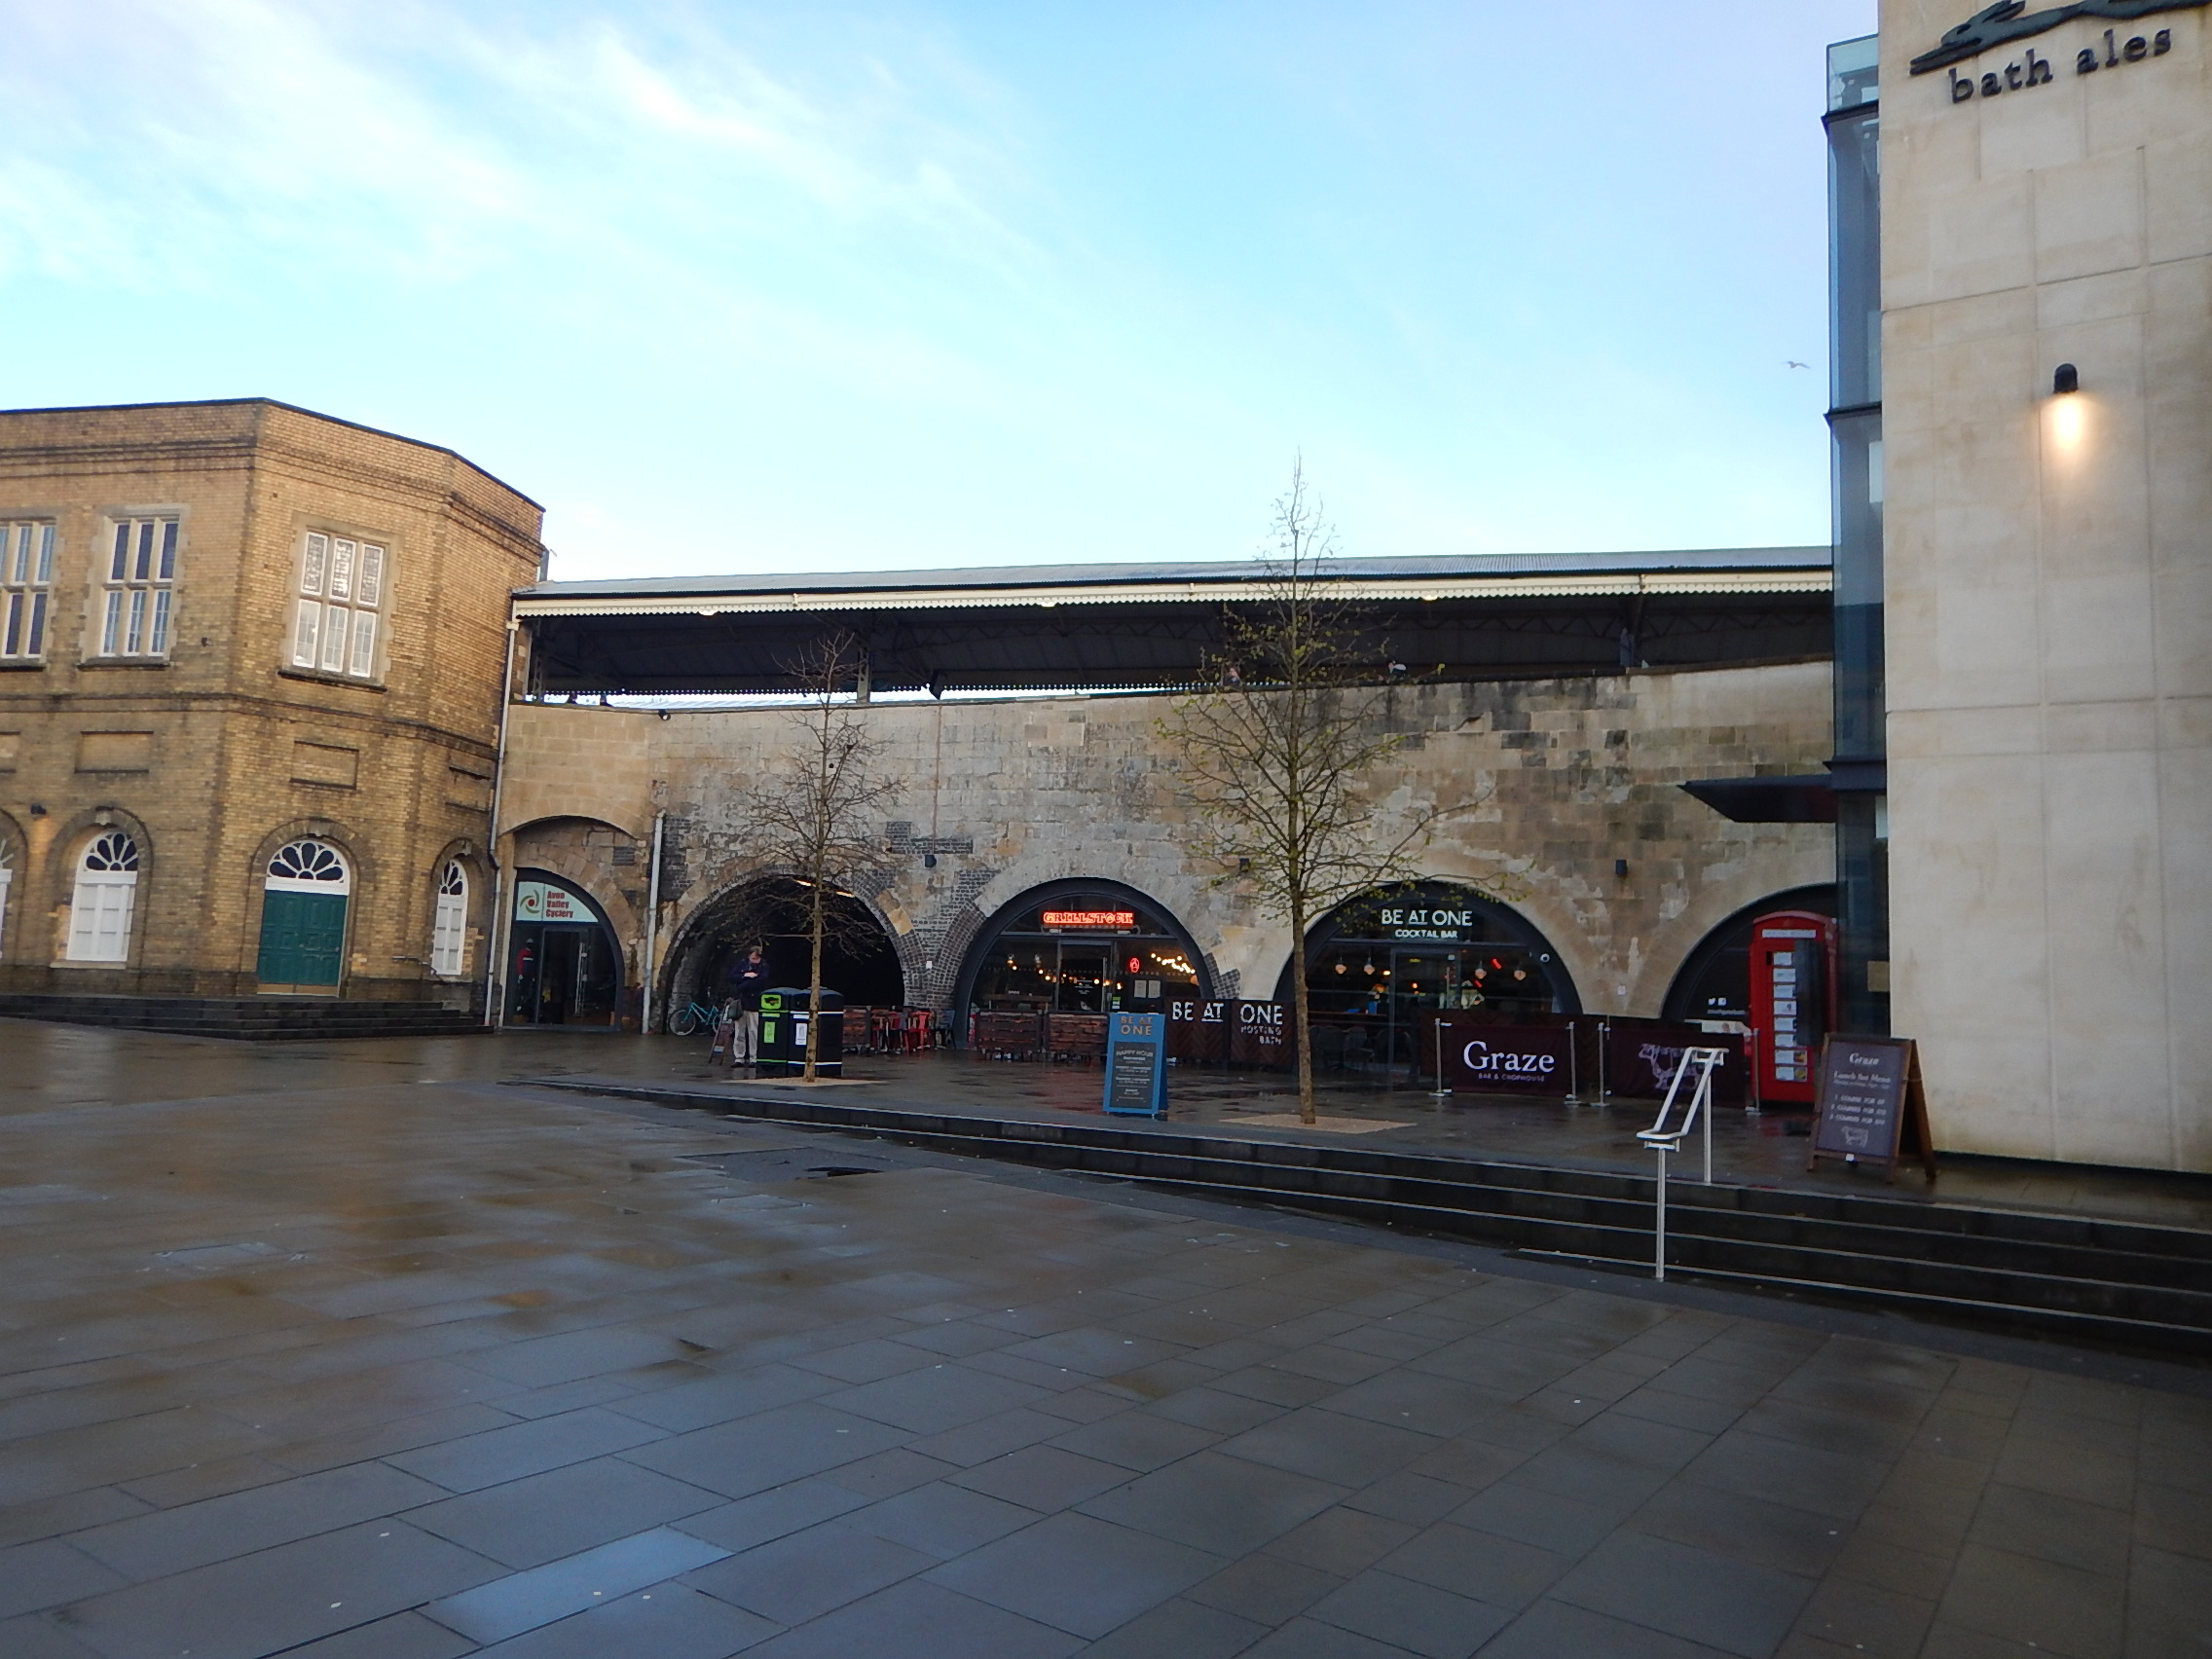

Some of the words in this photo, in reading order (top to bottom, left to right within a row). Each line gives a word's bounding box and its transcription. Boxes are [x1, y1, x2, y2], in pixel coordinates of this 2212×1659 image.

[1948, 48, 2053, 104] bath
[2076, 28, 2172, 75] ales
[545, 909, 574, 918] Cyclery
[1043, 911, 1134, 924] GRILLSTOCK
[1382, 908, 1404, 925] BE
[1408, 909, 1428, 925] AT
[1431, 909, 1473, 926] ONE
[1394, 929, 1439, 939] COCKTAIL
[1441, 930, 1457, 939] BAR
[1121, 1015, 1134, 1024] BE
[1172, 1001, 1195, 1021] BE
[1201, 1002, 1225, 1022] AT
[1239, 1003, 1284, 1025] ONE
[1121, 1024, 1153, 1036] ONE
[1463, 1040, 1555, 1073] Graze
